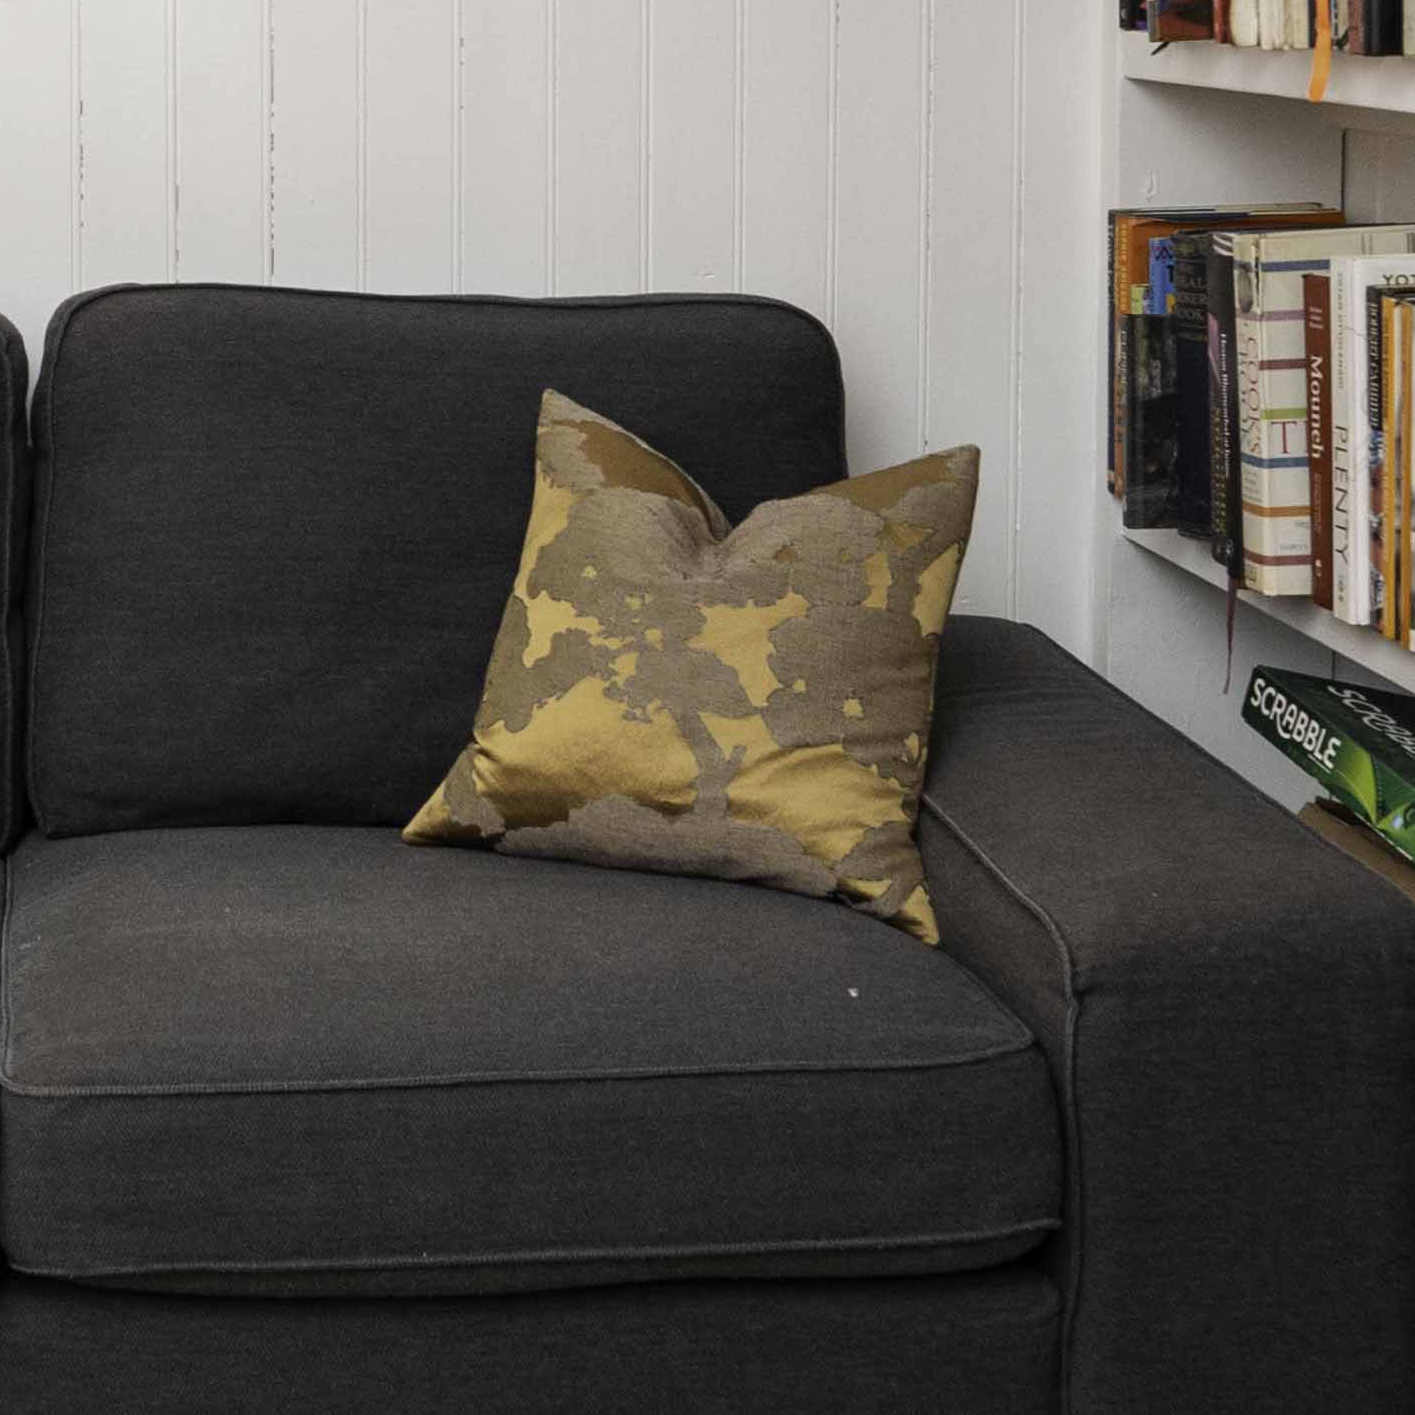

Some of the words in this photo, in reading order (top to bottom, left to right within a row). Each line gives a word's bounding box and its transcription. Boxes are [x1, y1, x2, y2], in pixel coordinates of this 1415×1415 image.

[1221, 373, 1229, 436] Blumenthal
[1334, 425, 1348, 565] PLENTY
[1250, 678, 1341, 769] SCRABBLE
